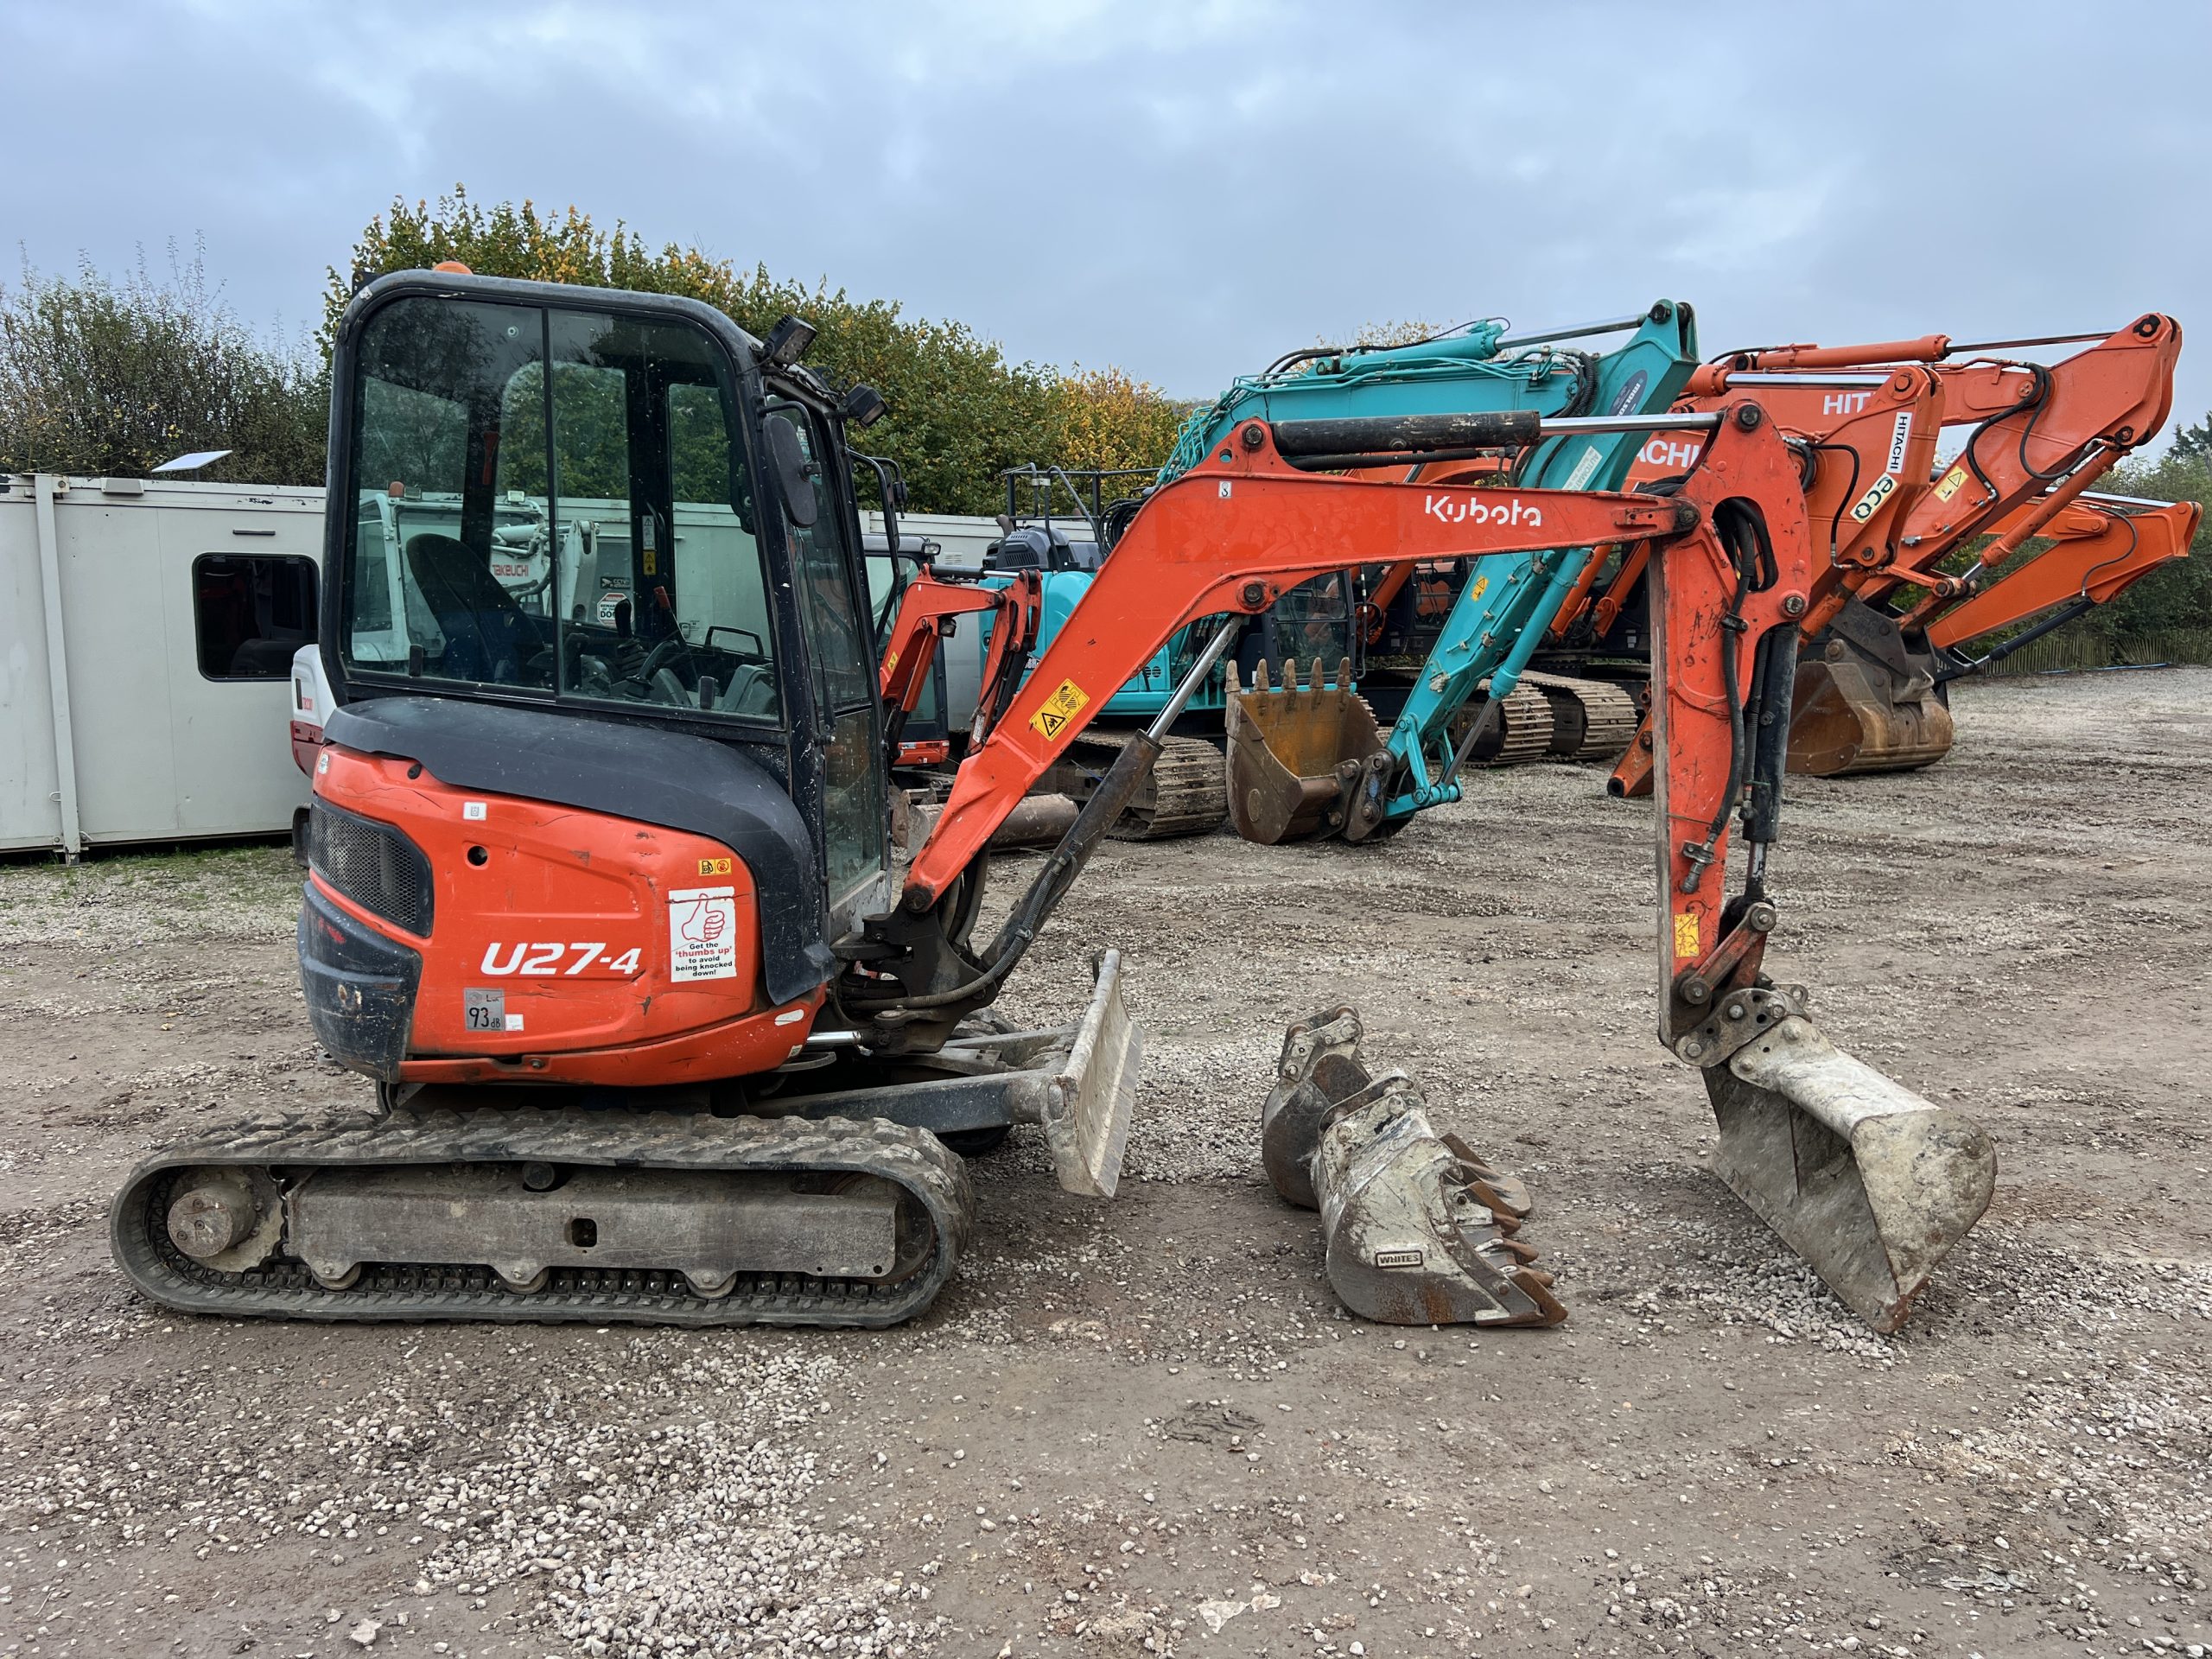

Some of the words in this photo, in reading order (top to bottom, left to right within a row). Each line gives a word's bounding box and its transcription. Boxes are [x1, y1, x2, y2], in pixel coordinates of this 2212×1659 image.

[1890, 416, 1908, 469] HITACHI
[1425, 495, 1541, 526] Kubota
[1854, 477, 1893, 518] eco
[492, 564, 529, 576] TAKEUCHI
[480, 943, 642, 975] U27-4
[700, 961, 733, 969] knocked
[469, 1007, 489, 1027] 93
[491, 1018, 501, 1028] dB
[1379, 1255, 1419, 1263] WHITES
